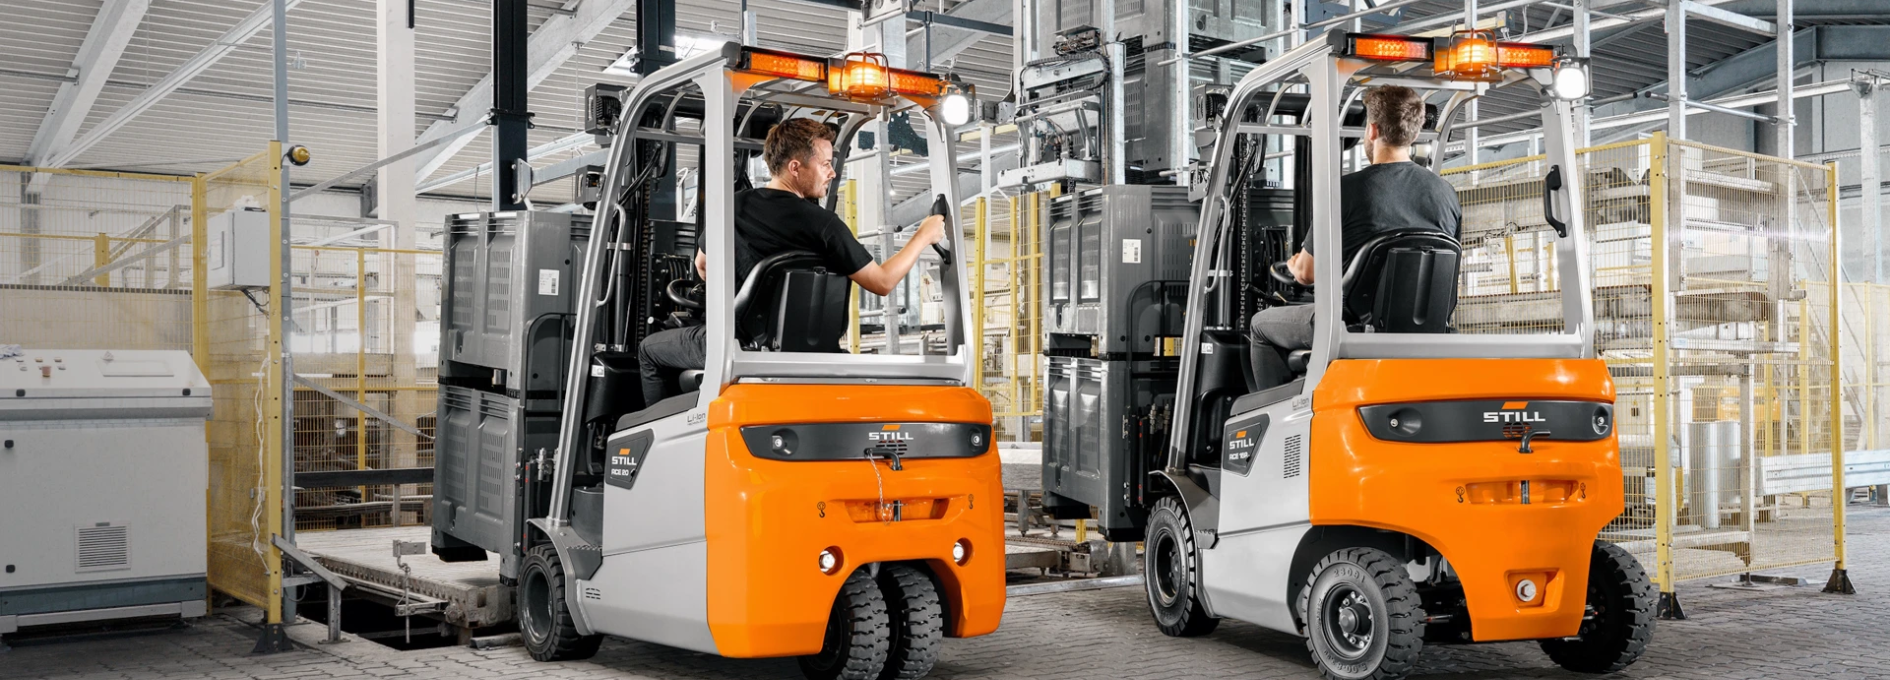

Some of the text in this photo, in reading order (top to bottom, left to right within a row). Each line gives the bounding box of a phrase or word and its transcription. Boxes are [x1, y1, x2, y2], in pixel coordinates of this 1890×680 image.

[1483, 411, 1546, 422] STILL
[868, 432, 914, 440] STILL
[1229, 438, 1254, 450] STILL
[611, 456, 637, 466] STILL
